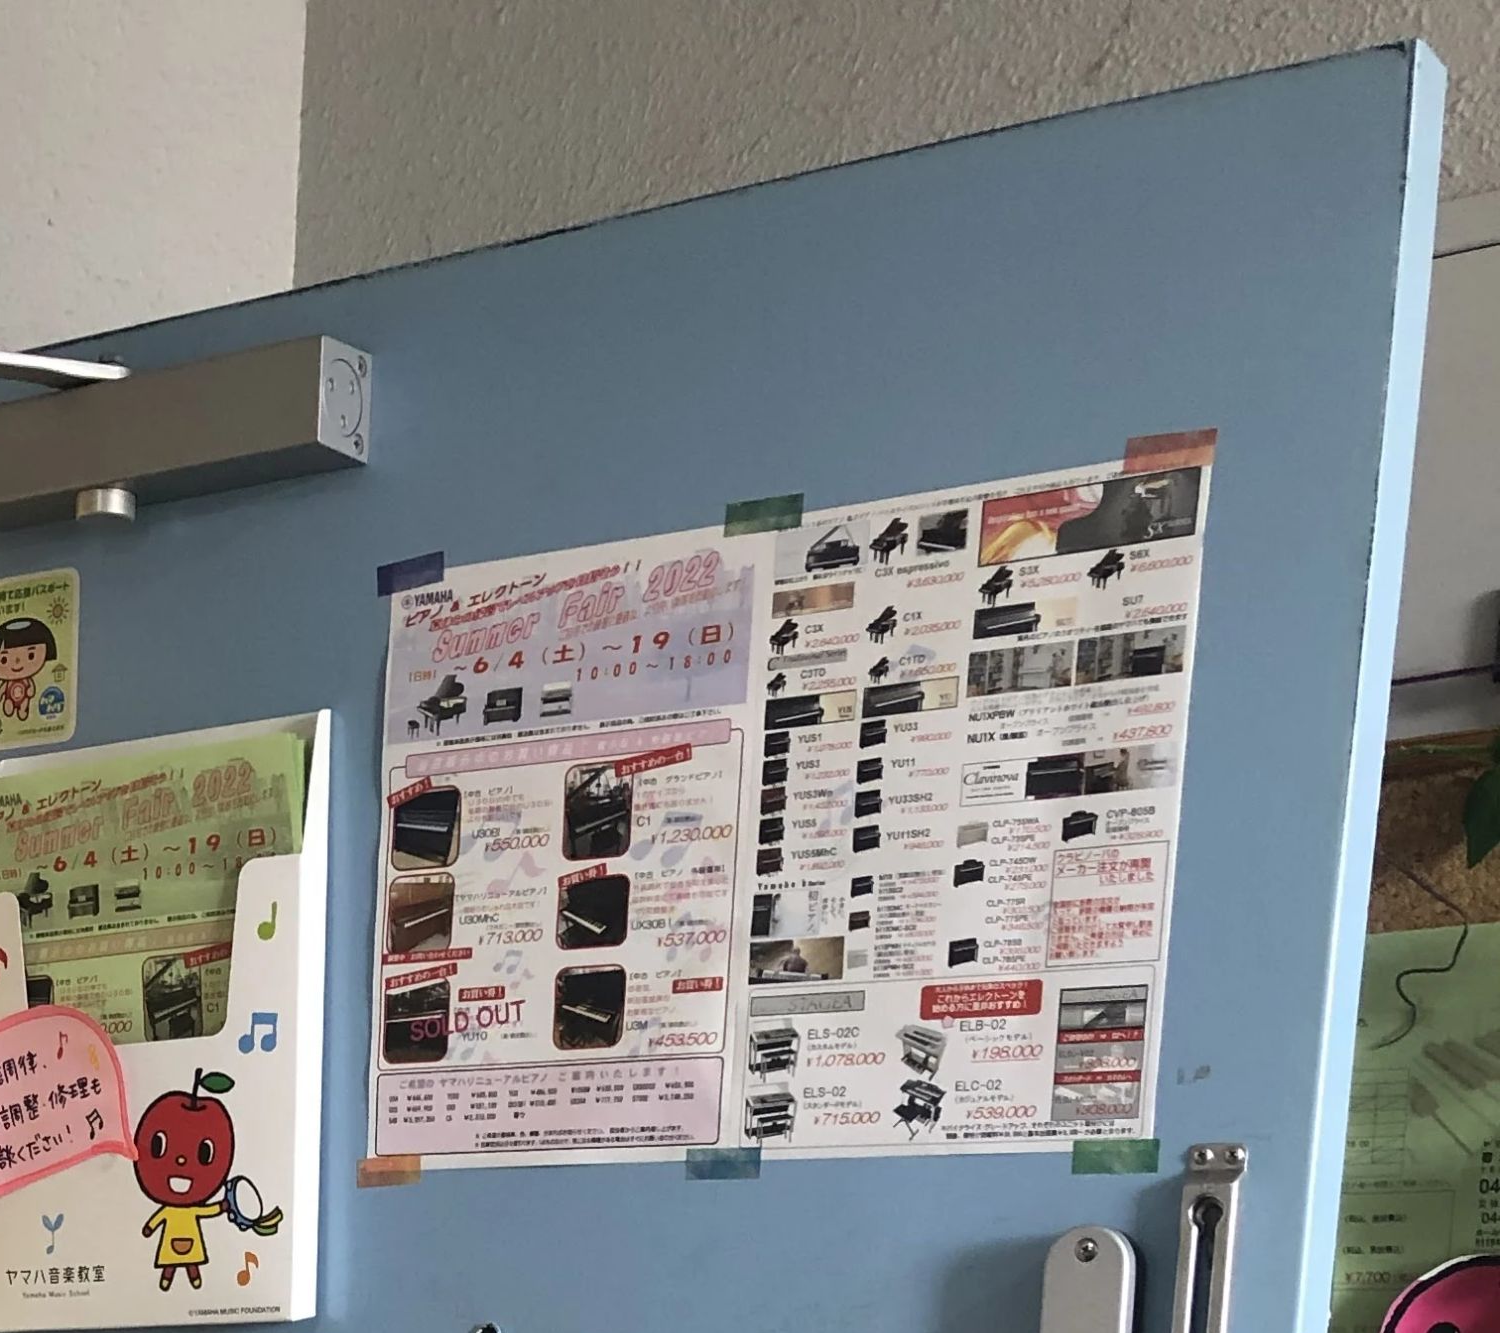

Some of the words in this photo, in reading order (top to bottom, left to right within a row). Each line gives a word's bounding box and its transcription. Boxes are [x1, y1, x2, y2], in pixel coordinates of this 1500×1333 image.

[404, 605, 445, 628] ピアノ
[468, 572, 547, 608] エレクトーン
[413, 588, 453, 605] YAMAHA
[432, 611, 541, 663] Summer
[558, 581, 625, 629] Fair
[642, 550, 720, 603] 2022
[798, 733, 823, 743] YUS1
[967, 732, 996, 744] NU1X
[962, 770, 1019, 786] Clavinova
[36, 779, 102, 810] エレクトーン
[14, 815, 105, 863] Summer
[121, 787, 182, 832] Fair
[191, 760, 256, 809] 2022
[636, 814, 651, 828] C1
[206, 1003, 220, 1014] C1
[410, 1011, 470, 1041] SOLD
[476, 1000, 526, 1028] OUT
[626, 1020, 648, 1031] U3M
[959, 1019, 1007, 1032] ELB-02
[461, 1030, 488, 1041] YU10
[807, 1026, 860, 1040] ELS-02C
[803, 1086, 847, 1098] ELS-02
[955, 1079, 1003, 1092] ELC-02
[5, 1264, 106, 1286] ヤマハ音楽教室
[22, 1291, 46, 1299] Yamaha
[220, 1307, 239, 1316] MUSIC
[240, 1305, 281, 1315] FOUNDATION
